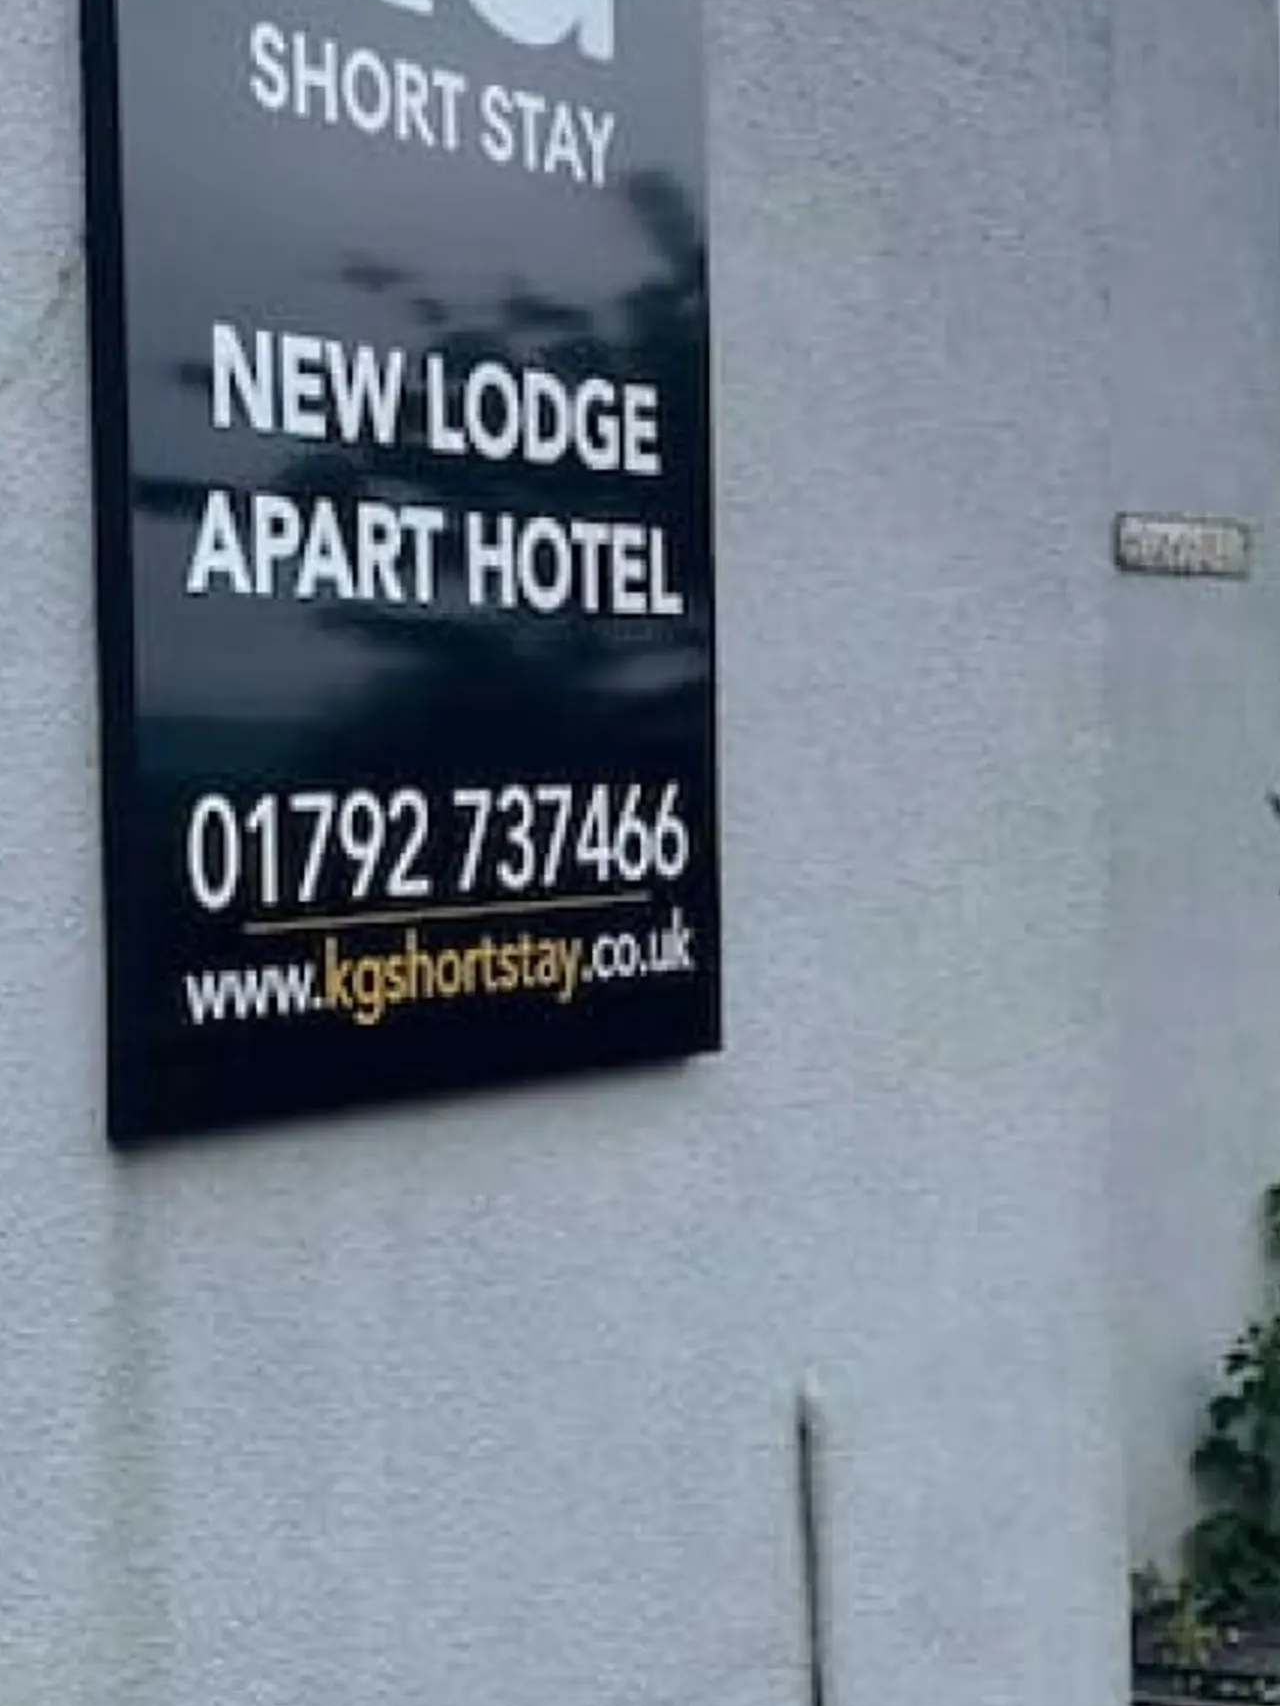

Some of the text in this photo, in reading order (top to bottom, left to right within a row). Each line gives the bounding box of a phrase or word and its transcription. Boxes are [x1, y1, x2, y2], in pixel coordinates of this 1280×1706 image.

[250, 21, 616, 188] SHORT STAY
[212, 322, 662, 476] NEW LODGE
[185, 490, 684, 615] APART HOTEL
[187, 781, 689, 910] 01792 737466
[185, 907, 695, 1026] www.kgshortstay.co.uk
